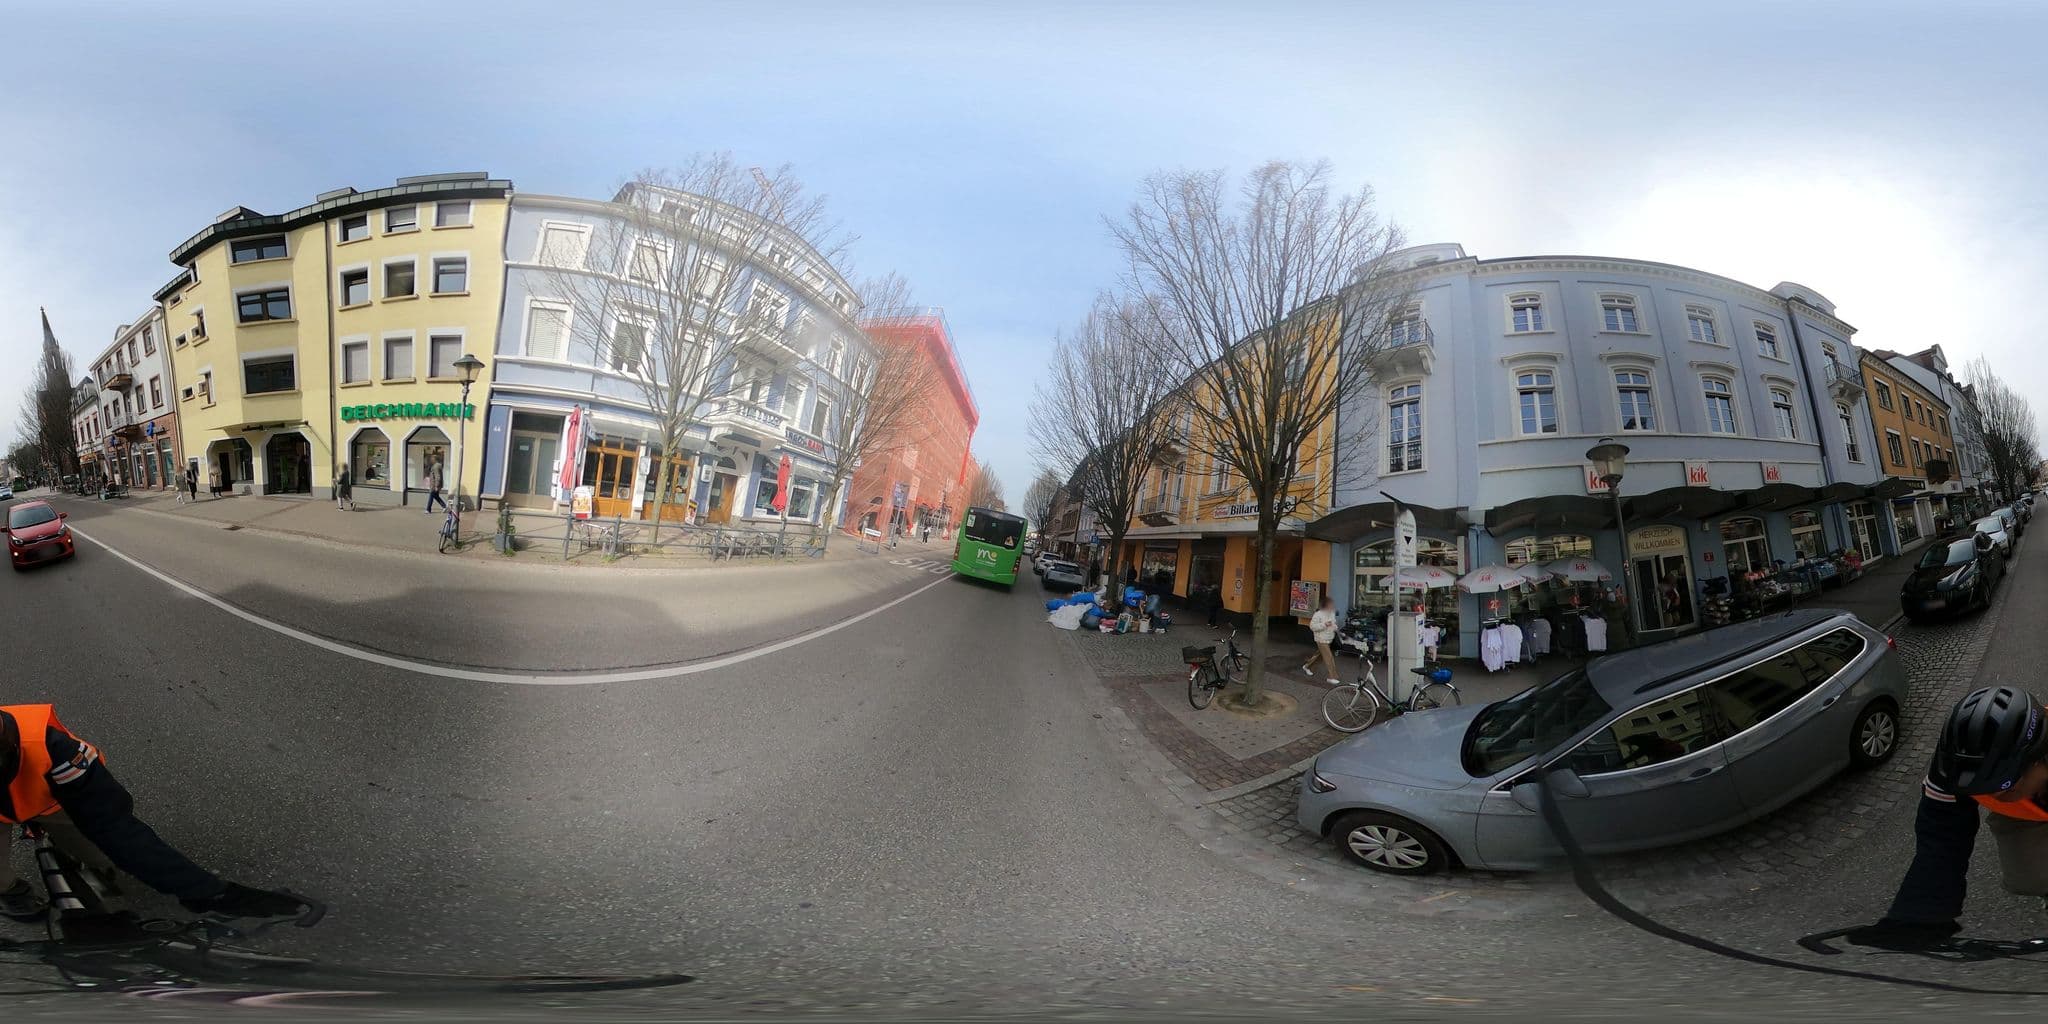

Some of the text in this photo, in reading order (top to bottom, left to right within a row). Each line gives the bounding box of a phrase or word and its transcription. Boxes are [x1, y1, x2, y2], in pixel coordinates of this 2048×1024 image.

[340, 402, 474, 421] DEICHMANN
[1690, 464, 1708, 482] kik
[1766, 466, 1780, 480] kik
[1230, 504, 1260, 515] Billard
[1638, 528, 1672, 539] HERZLICH
[1633, 536, 1681, 550] WILLKOMMEN
